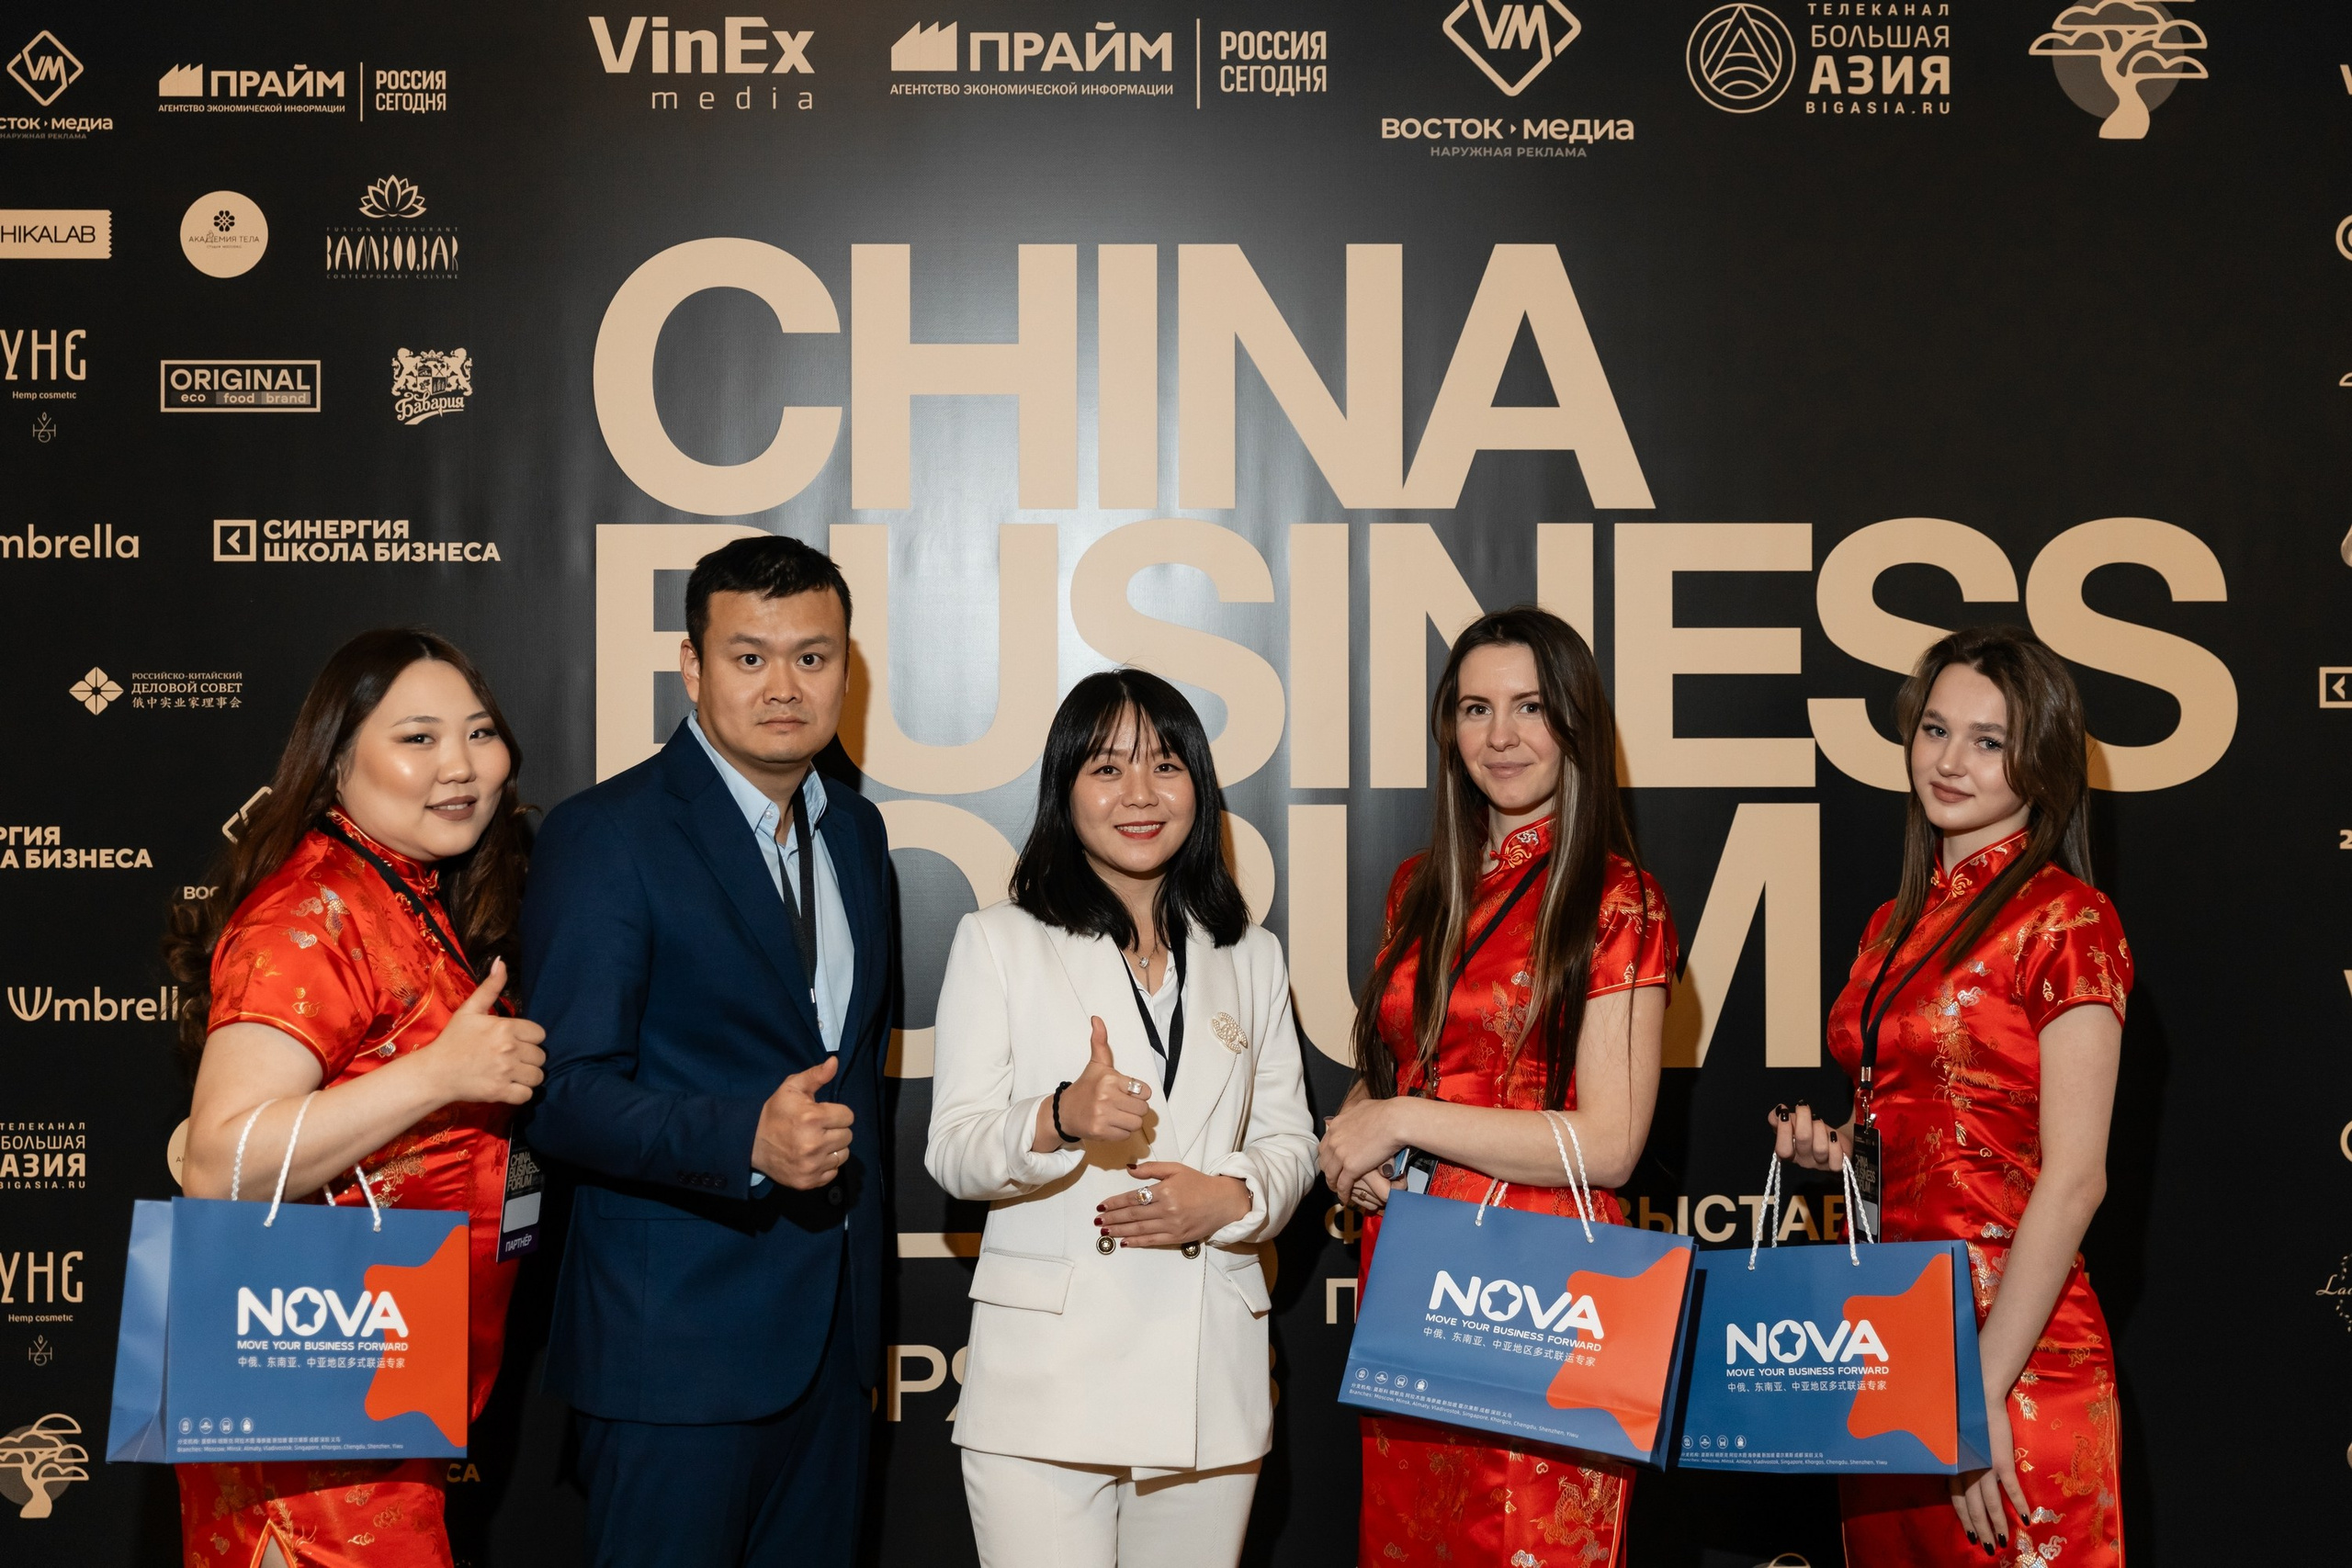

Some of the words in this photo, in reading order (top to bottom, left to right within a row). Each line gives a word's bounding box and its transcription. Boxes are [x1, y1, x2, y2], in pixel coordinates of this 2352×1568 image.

[1807, 4, 1949, 16] ТЕЛЕКАНАЛ
[588, 17, 815, 74] VinEx
[1220, 30, 1326, 62] РОССИЯ
[1812, 25, 1950, 48] БОЛЬШАЯ
[969, 21, 1173, 72] ПРАЙМ
[211, 63, 345, 96] ПРАЙМ
[376, 70, 446, 89] РОССИЯ
[1220, 65, 1326, 97] СЕГОДНЯ
[1809, 55, 1951, 95] АЗИЯ
[652, 85, 813, 110] media
[889, 84, 959, 96] АГЕНТСТВО
[964, 82, 1077, 96] ЭКОНОМИЧЕСКОЙ
[1081, 84, 1173, 97] ИНФОРМАЦИИ
[207, 103, 281, 112] ЭКОНОМИЧЕСКОЙ
[285, 105, 345, 113] ИНФОРМАЦИИ
[376, 93, 446, 114] СЕГОДНЯ
[1806, 102, 1951, 114] BIGASIA.RU
[1382, 118, 1503, 139] ВОСТОК
[1430, 147, 1511, 157] НАРУЖНАЯ
[1517, 147, 1587, 157] РЕКЛАМА
[0, 225, 96, 243] HIKALAB
[170, 369, 311, 390] ORIGINAL
[593, 236, 1656, 516] CHINA
[13, 391, 37, 400] Hemp
[181, 394, 206, 402] eco
[223, 392, 254, 403] food
[266, 392, 306, 403] brand
[395, 391, 465, 421] Бавария
[263, 520, 409, 539] СИНЕРГИЯ
[264, 542, 368, 561] ШКОЛА
[375, 542, 501, 561] БИЗНЕСА
[132, 671, 243, 680] РОССИЙСКО-КИТАЙСКИЙ
[131, 681, 197, 694] ДЕЛОВОЙ
[200, 683, 243, 693] СОВЕТ
[132, 696, 243, 709] 俄中实业家理事会
[26, 849, 153, 868] БИЗНЕСА
[1, 1135, 85, 1150] БОЛЬШАЯ
[0, 1153, 86, 1178] АЗИЯ
[505, 1234, 532, 1252] ПАРТНЁР
[237, 1287, 409, 1337] NOVA
[1429, 1270, 1604, 1339] NOVA
[8, 1314, 33, 1323] Hemp
[1425, 1314, 1458, 1325] MOVE
[1462, 1320, 1489, 1332] YOUR
[1493, 1325, 1544, 1341] BUSINESS
[1547, 1336, 1601, 1352] FORWARD
[1726, 1319, 1889, 1364] NOVA
[237, 1340, 268, 1350] MOVE
[273, 1341, 300, 1350] YOUR
[304, 1341, 355, 1350] BUSINESS
[358, 1342, 408, 1351] FORWARD
[1423, 1326, 1595, 1367] 中俄、东南亚、中亚地区多式联运专家
[1759, 1368, 1785, 1376] YOUR
[1789, 1367, 1834, 1375] BUSINESS
